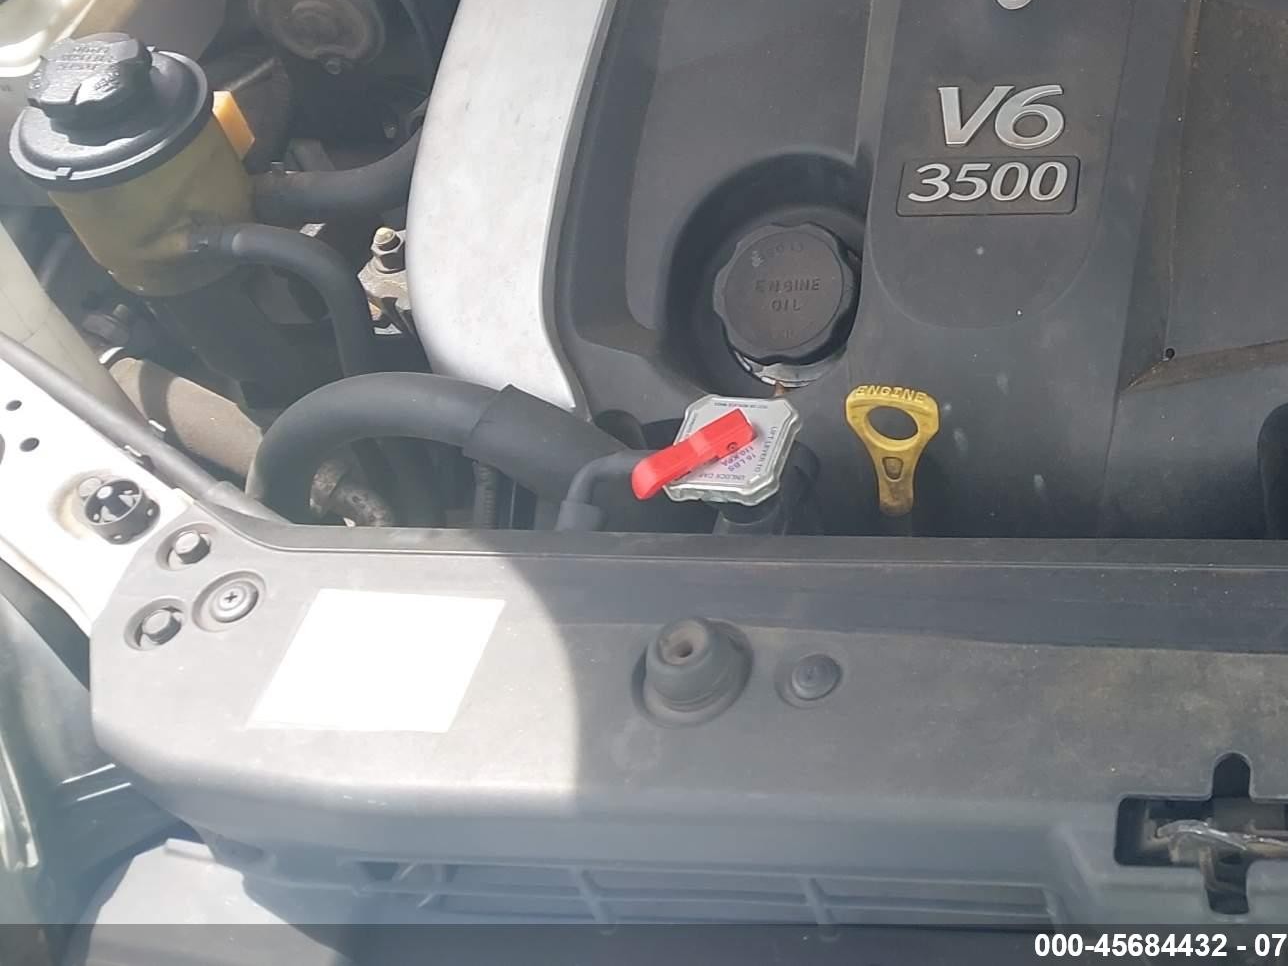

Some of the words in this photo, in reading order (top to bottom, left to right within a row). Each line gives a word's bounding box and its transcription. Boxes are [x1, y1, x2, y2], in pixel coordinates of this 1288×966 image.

[938, 84, 1065, 149] V6
[907, 161, 1068, 202] 3500
[755, 279, 821, 292] ENGINE
[772, 298, 801, 311] OIL
[856, 385, 927, 403] ENGINE
